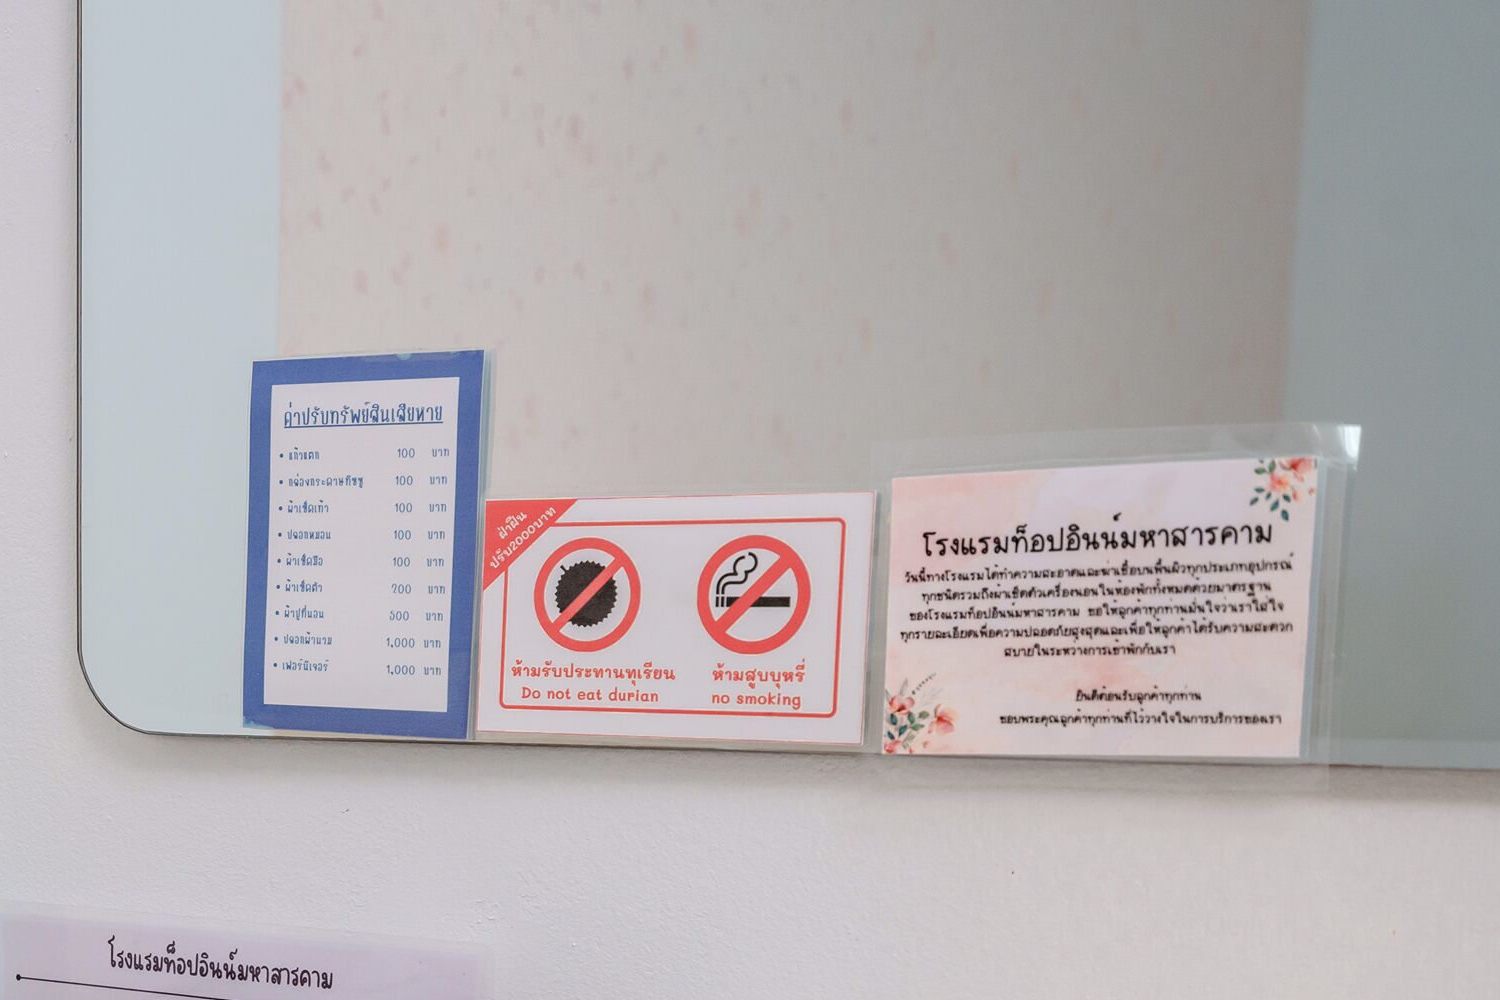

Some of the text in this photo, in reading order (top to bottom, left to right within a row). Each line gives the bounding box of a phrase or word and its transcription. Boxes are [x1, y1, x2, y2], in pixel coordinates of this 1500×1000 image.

[284, 402, 443, 426] ค่าปรับทรัพย์สินเสียหาย
[397, 448, 415, 459] 100
[432, 448, 450, 458] บาท
[395, 475, 413, 486] 100
[429, 475, 447, 485] บาท
[287, 500, 447, 513] ผ้าเช็ดเท้า 100 บาท
[497, 512, 528, 539] ฝ่าฝืน
[393, 530, 411, 540] 100
[428, 530, 446, 540] บาท
[923, 512, 1273, 557] โรงแรมท็อปอินน์มหาสารคาม
[393, 556, 411, 567] 100
[426, 557, 444, 567] บาท
[285, 579, 446, 594] ผ้าเช็ดตัว 200 บาท
[389, 610, 410, 622] 500
[426, 611, 443, 622] บาท
[423, 638, 441, 649] บาท
[423, 666, 442, 676] บาท
[511, 659, 676, 686] ห้ามรับประทานทุเรียน
[712, 658, 805, 689] ห้ามสูบบุหรี่
[521, 686, 659, 702] Do not eat durian
[711, 691, 801, 710] no smoking
[107, 934, 333, 990] โรงแรมท็อปอินน์มหาสารคาม
